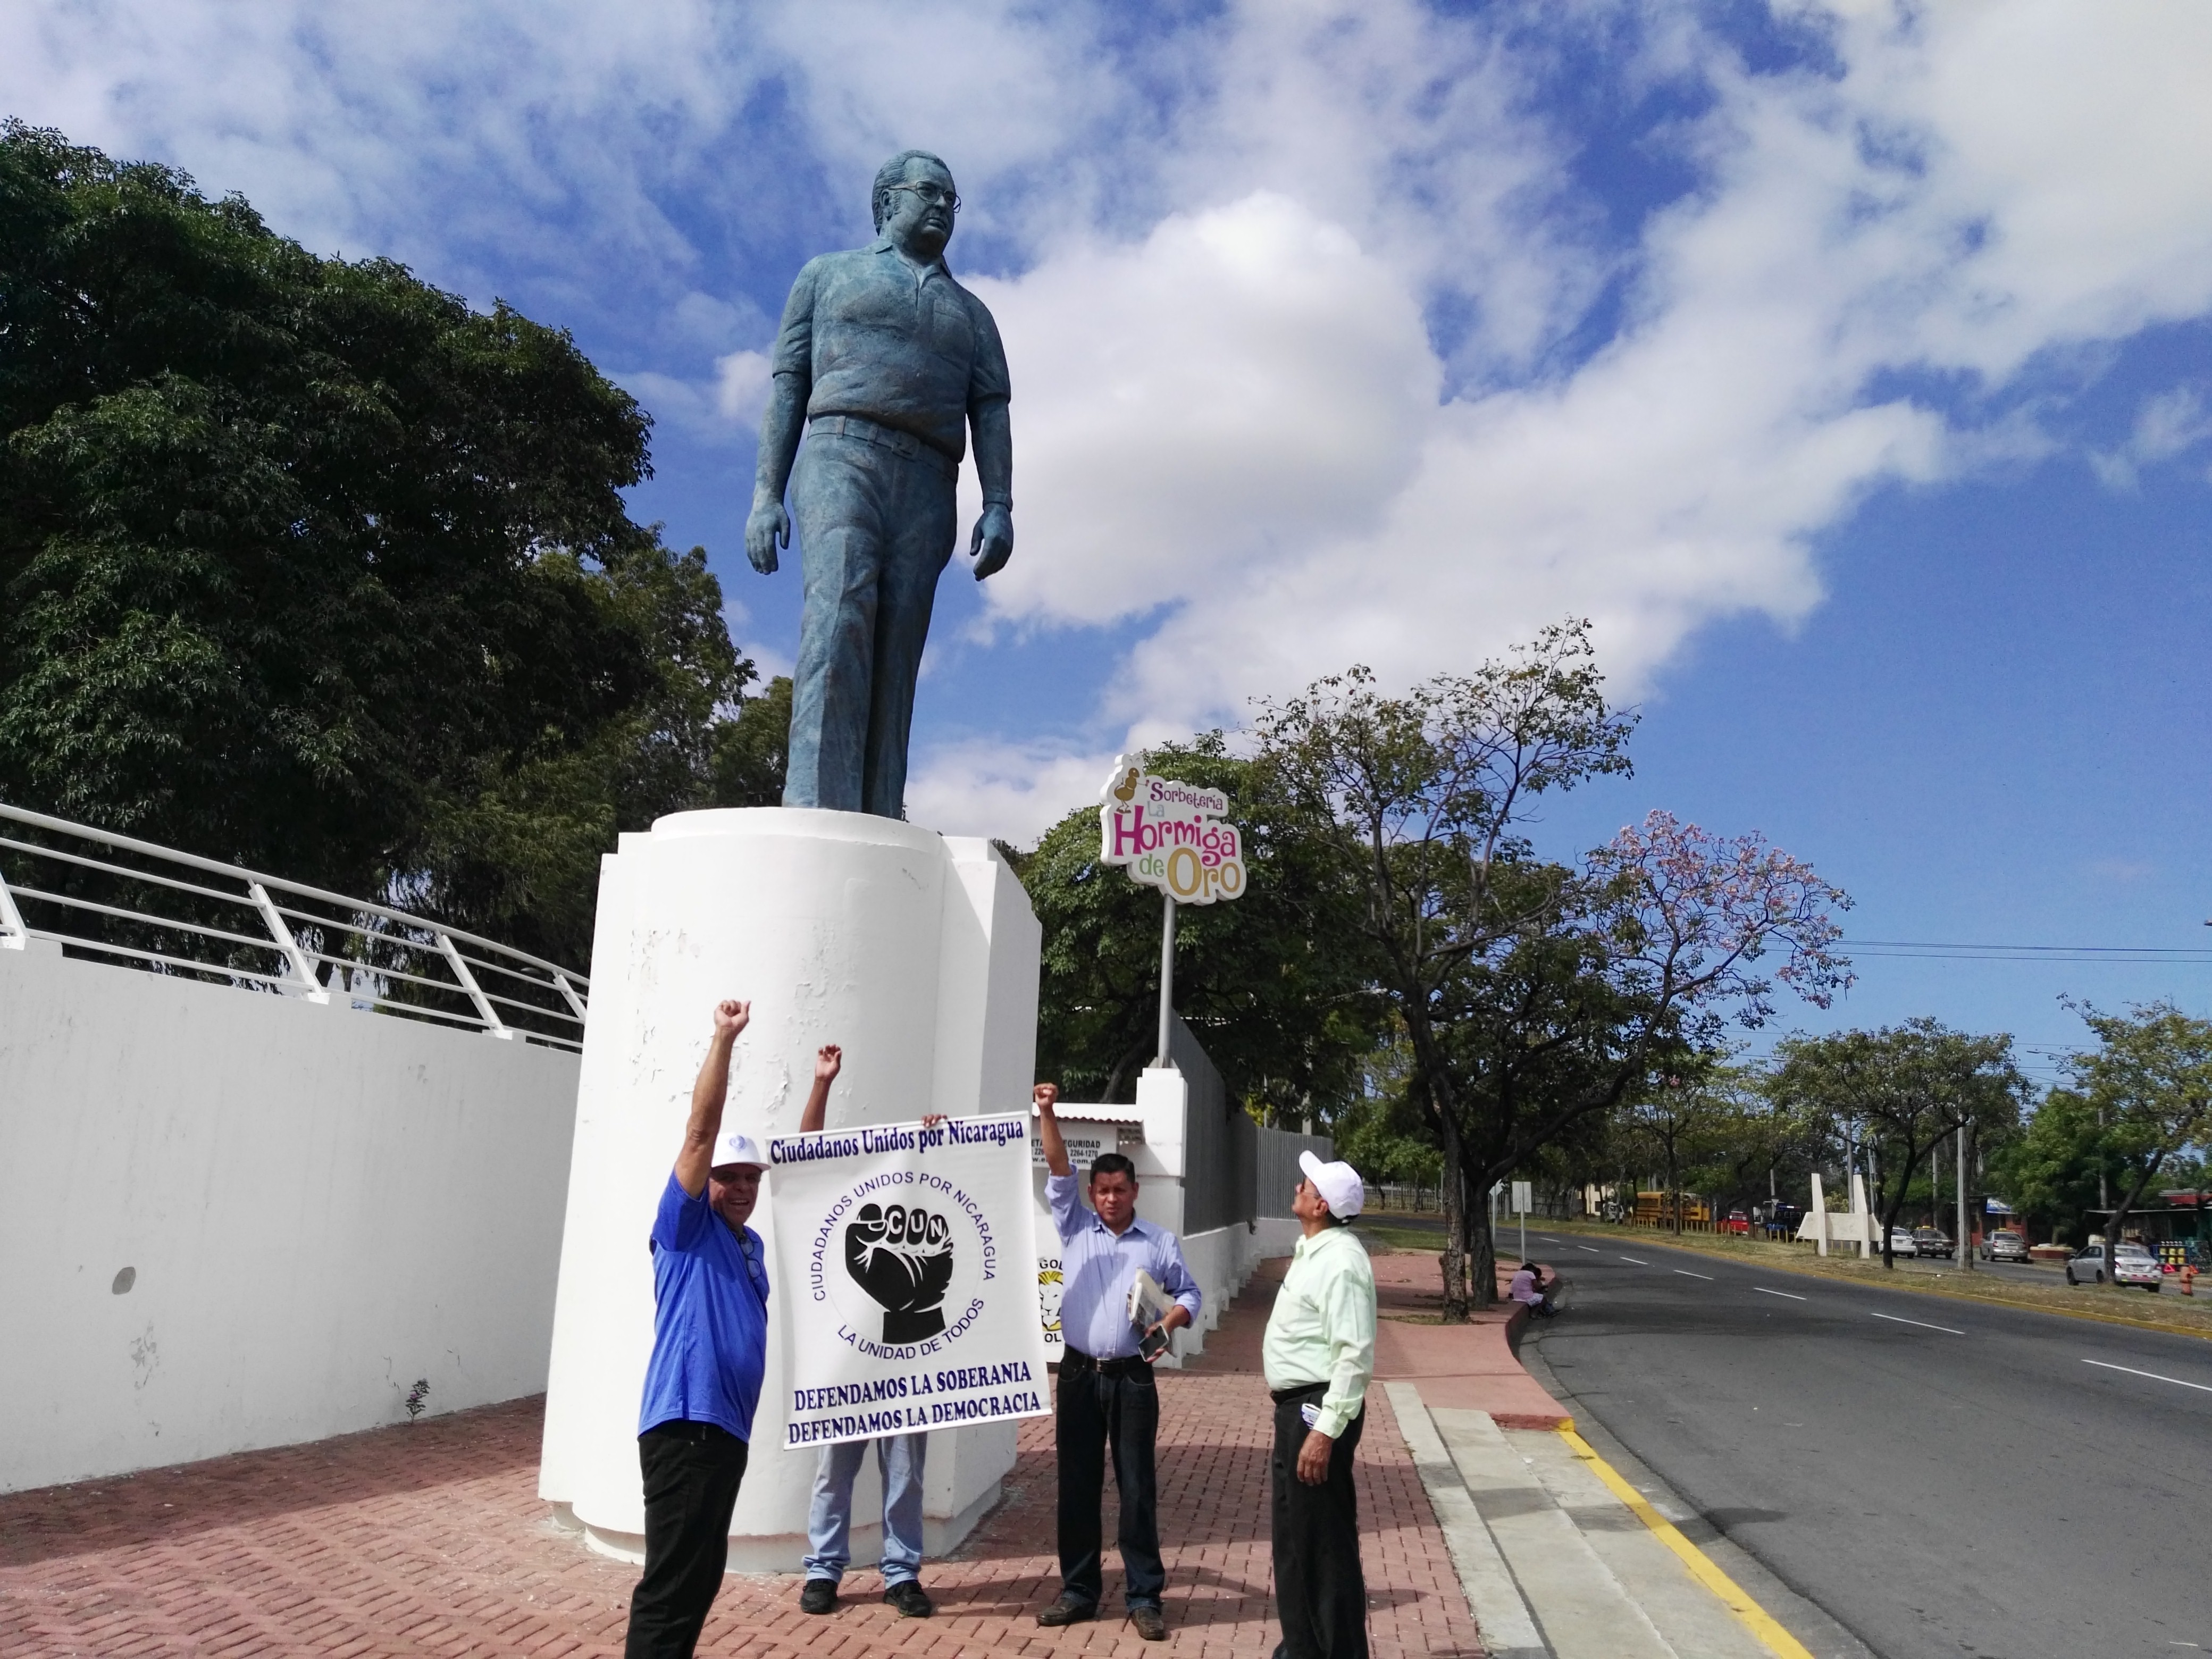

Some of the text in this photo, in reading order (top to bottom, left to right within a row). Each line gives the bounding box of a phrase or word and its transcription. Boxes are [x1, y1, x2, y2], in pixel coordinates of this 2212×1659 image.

[1147, 800, 1165, 817] La
[1150, 782, 1223, 810] Sorbetería
[1113, 805, 1236, 866] Hormiga
[1139, 848, 1241, 898] de Oro
[770, 1120, 1024, 1164] Ciudadanos Unidos por Nicaragua
[1063, 1139, 1101, 1149] EGURIDAD
[810, 1171, 996, 1301] CIUDADANOS UNIDOS POR NICARAGUA
[837, 1297, 985, 1360] LA UNIDAD DE TODOS
[794, 1361, 1032, 1411] DEFENDAMOS LA SOBERANIA
[788, 1391, 1041, 1444] DEFENDAMOS LA DEMOCRACIA
